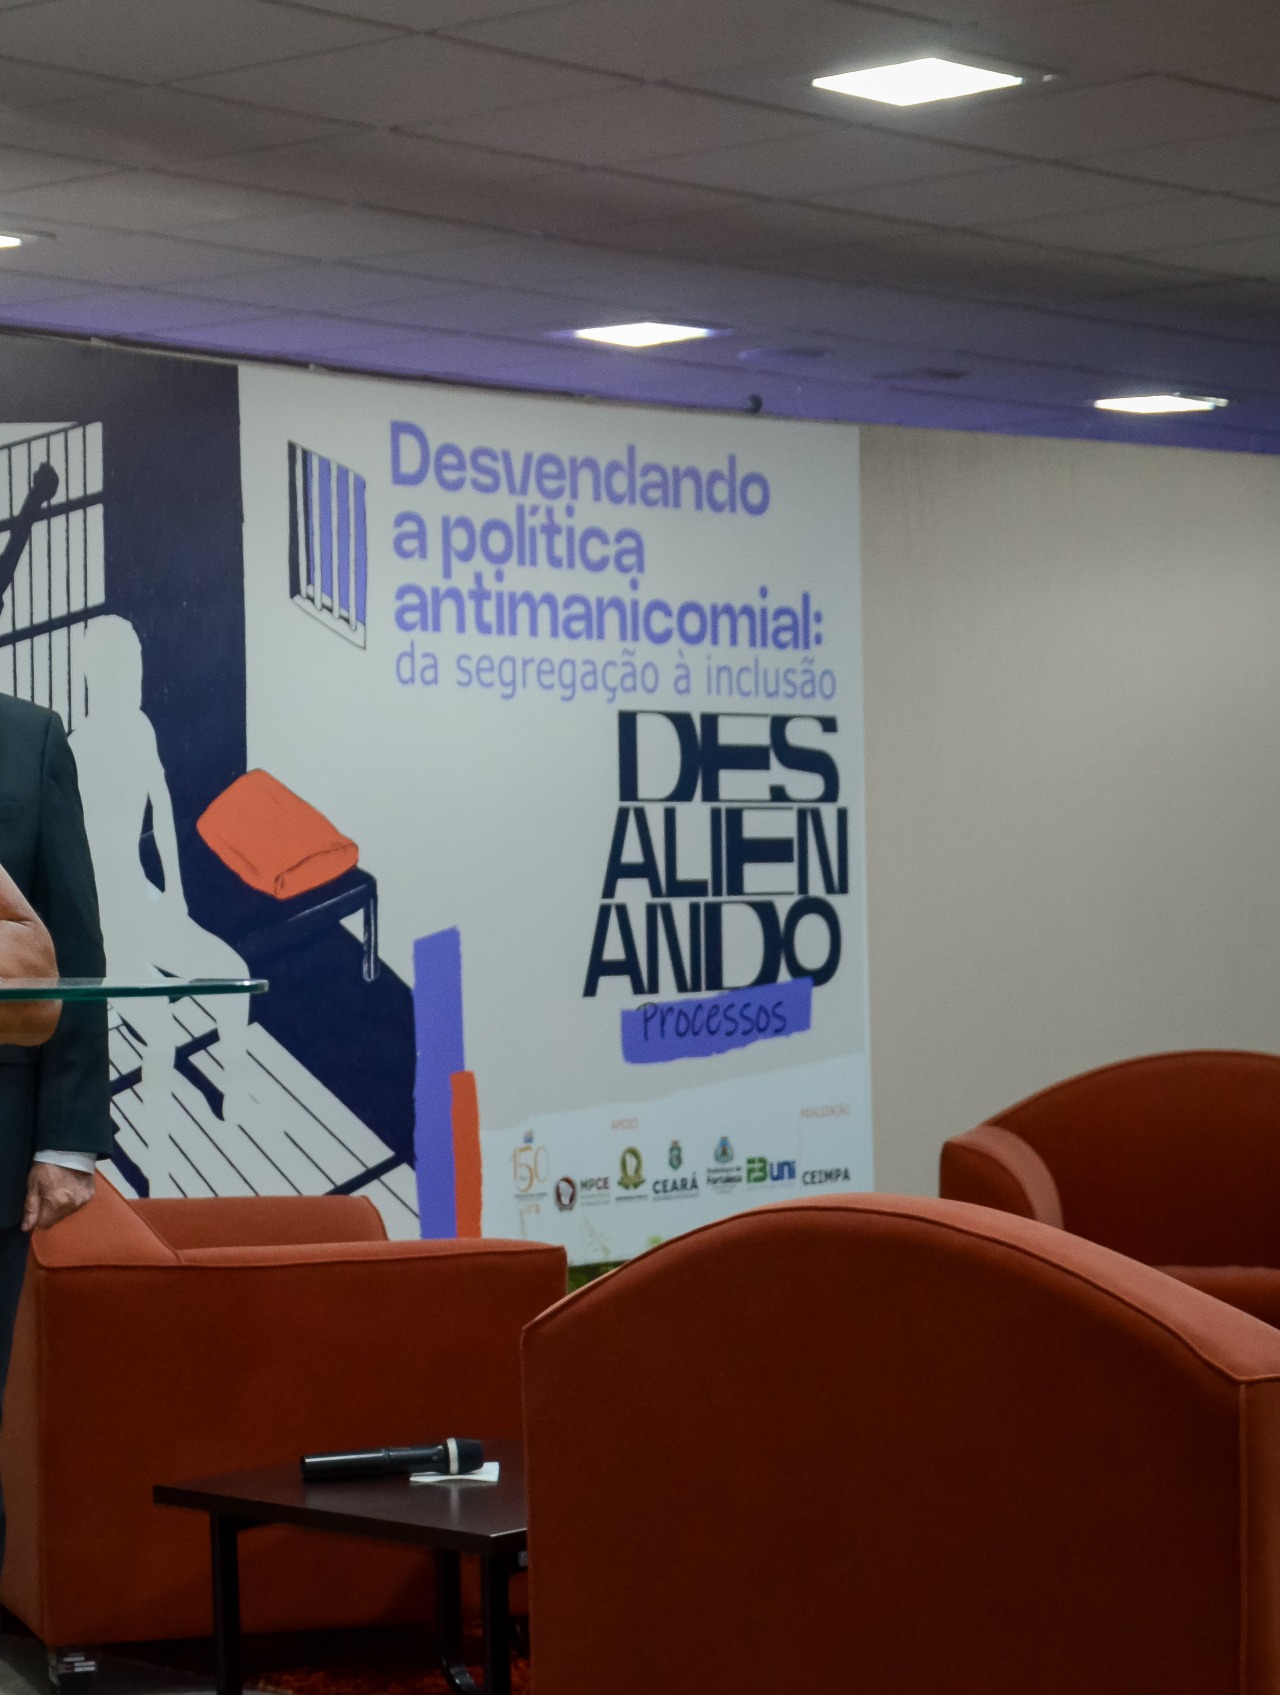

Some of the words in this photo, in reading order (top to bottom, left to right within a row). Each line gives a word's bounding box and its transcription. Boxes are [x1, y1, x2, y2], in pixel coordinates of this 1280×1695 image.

[390, 420, 770, 517] Desvendando
[393, 511, 427, 560] a
[441, 503, 645, 580] política
[394, 568, 824, 651] antimanicomial:
[395, 641, 439, 686] da
[456, 649, 660, 703] segregação
[673, 649, 691, 696] à
[706, 655, 837, 700] inclusão
[618, 710, 840, 804] DES
[601, 806, 849, 899] ALIEN
[583, 895, 842, 998] ANDO
[636, 1001, 788, 1041] Processos
[652, 1172, 698, 1194] CEARÁ
